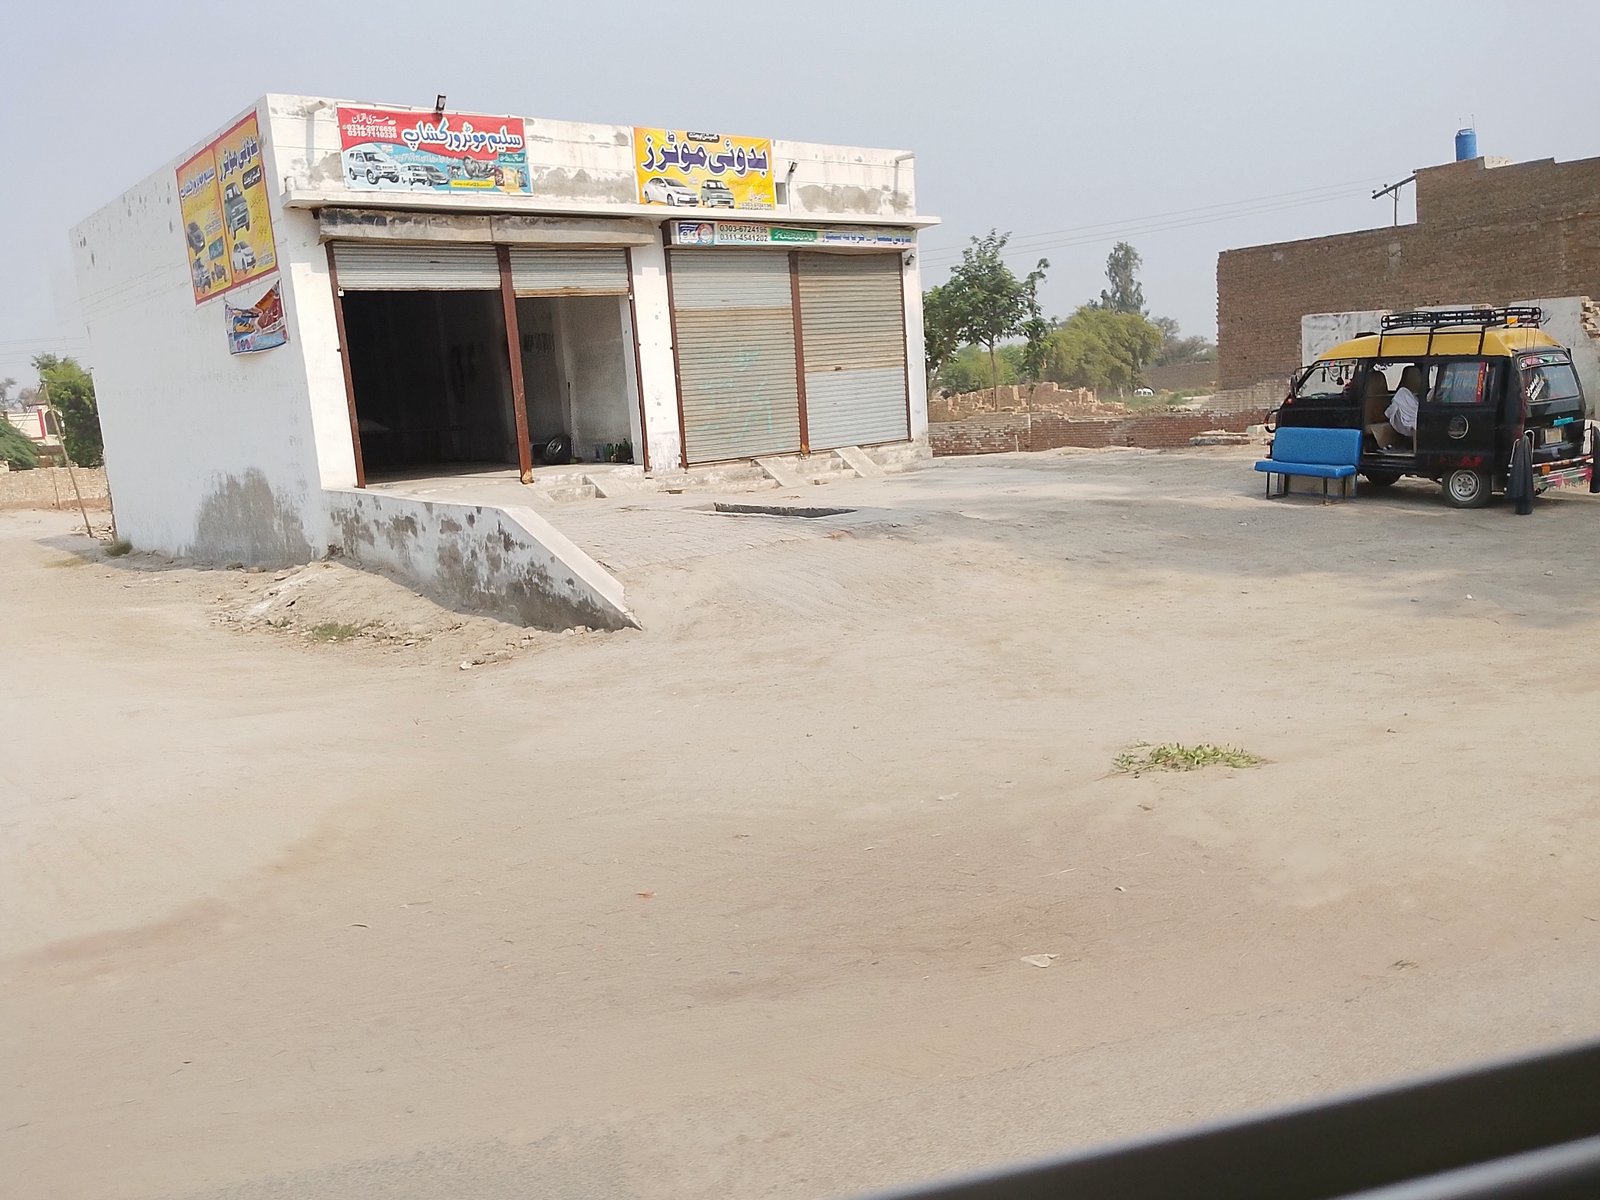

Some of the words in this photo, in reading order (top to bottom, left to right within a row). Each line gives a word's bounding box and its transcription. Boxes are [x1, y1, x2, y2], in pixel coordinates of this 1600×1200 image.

[402, 117, 463, 151] ورکشاپ
[461, 121, 488, 152] موٹر
[486, 125, 523, 153] سلیم
[641, 128, 708, 173] موٹرز
